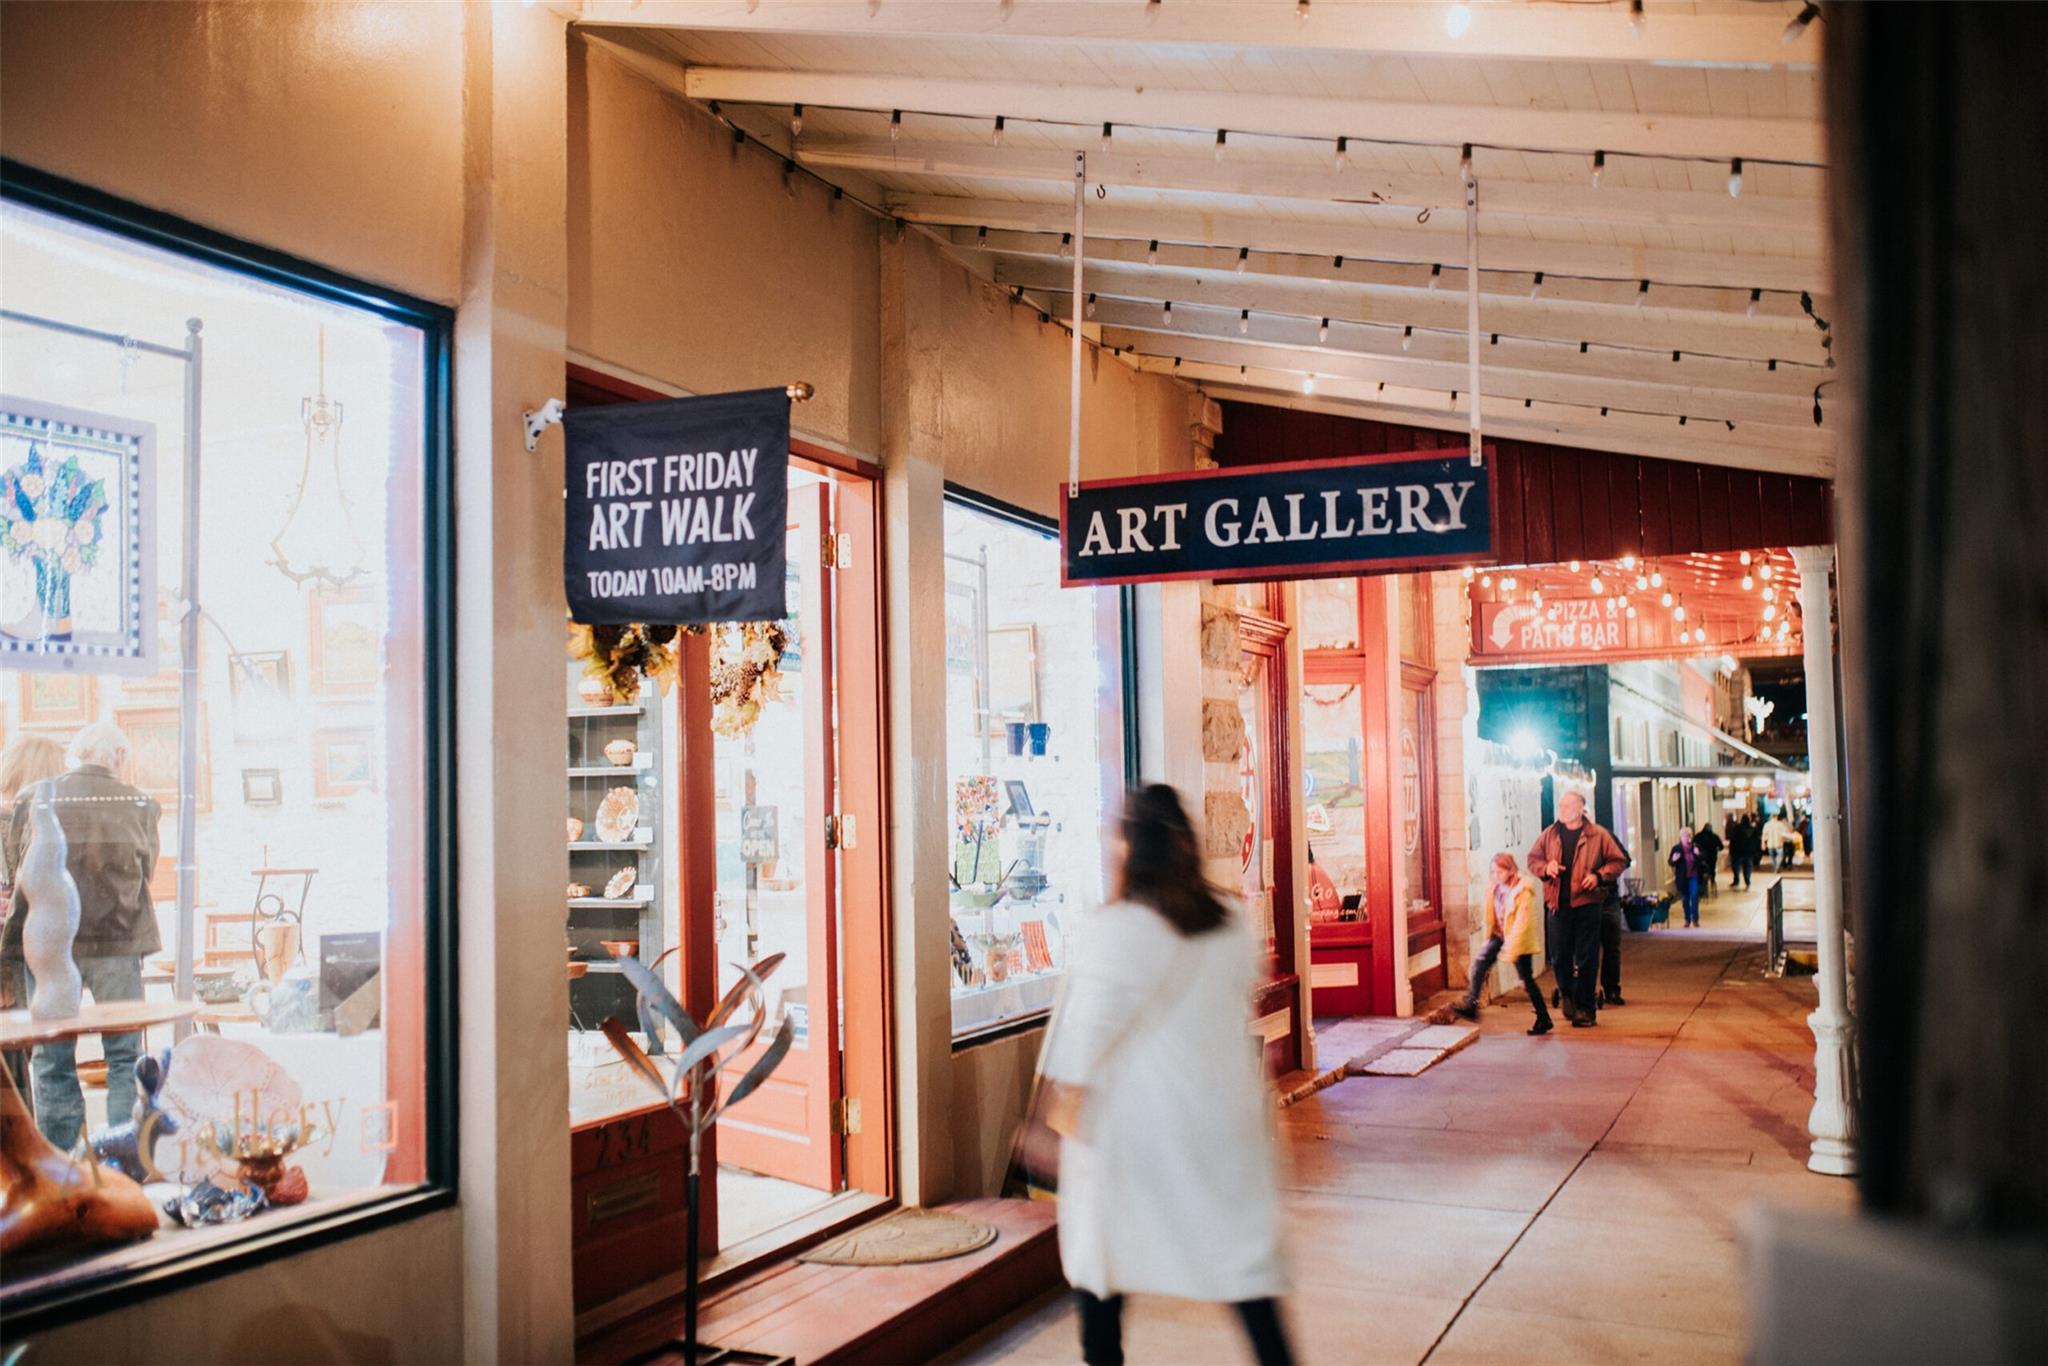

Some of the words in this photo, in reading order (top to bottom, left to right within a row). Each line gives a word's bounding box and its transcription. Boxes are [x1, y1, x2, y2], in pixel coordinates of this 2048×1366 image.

[586, 457, 658, 498] FIRST
[663, 447, 758, 493] FRIDAY
[589, 502, 653, 551] ART
[661, 492, 756, 546] WALK
[1078, 503, 1188, 557] ART
[1204, 480, 1476, 548] GALLERY
[587, 568, 648, 598] TODAY
[652, 562, 757, 595] 10AM-8PM
[1521, 622, 1575, 649] PATIO
[1580, 621, 1620, 647] BAR
[1553, 600, 1600, 621] PIZZA
[741, 839, 776, 857] OPEN
[138, 1087, 345, 1184] Gallery
[594, 1112, 652, 1169] 234
